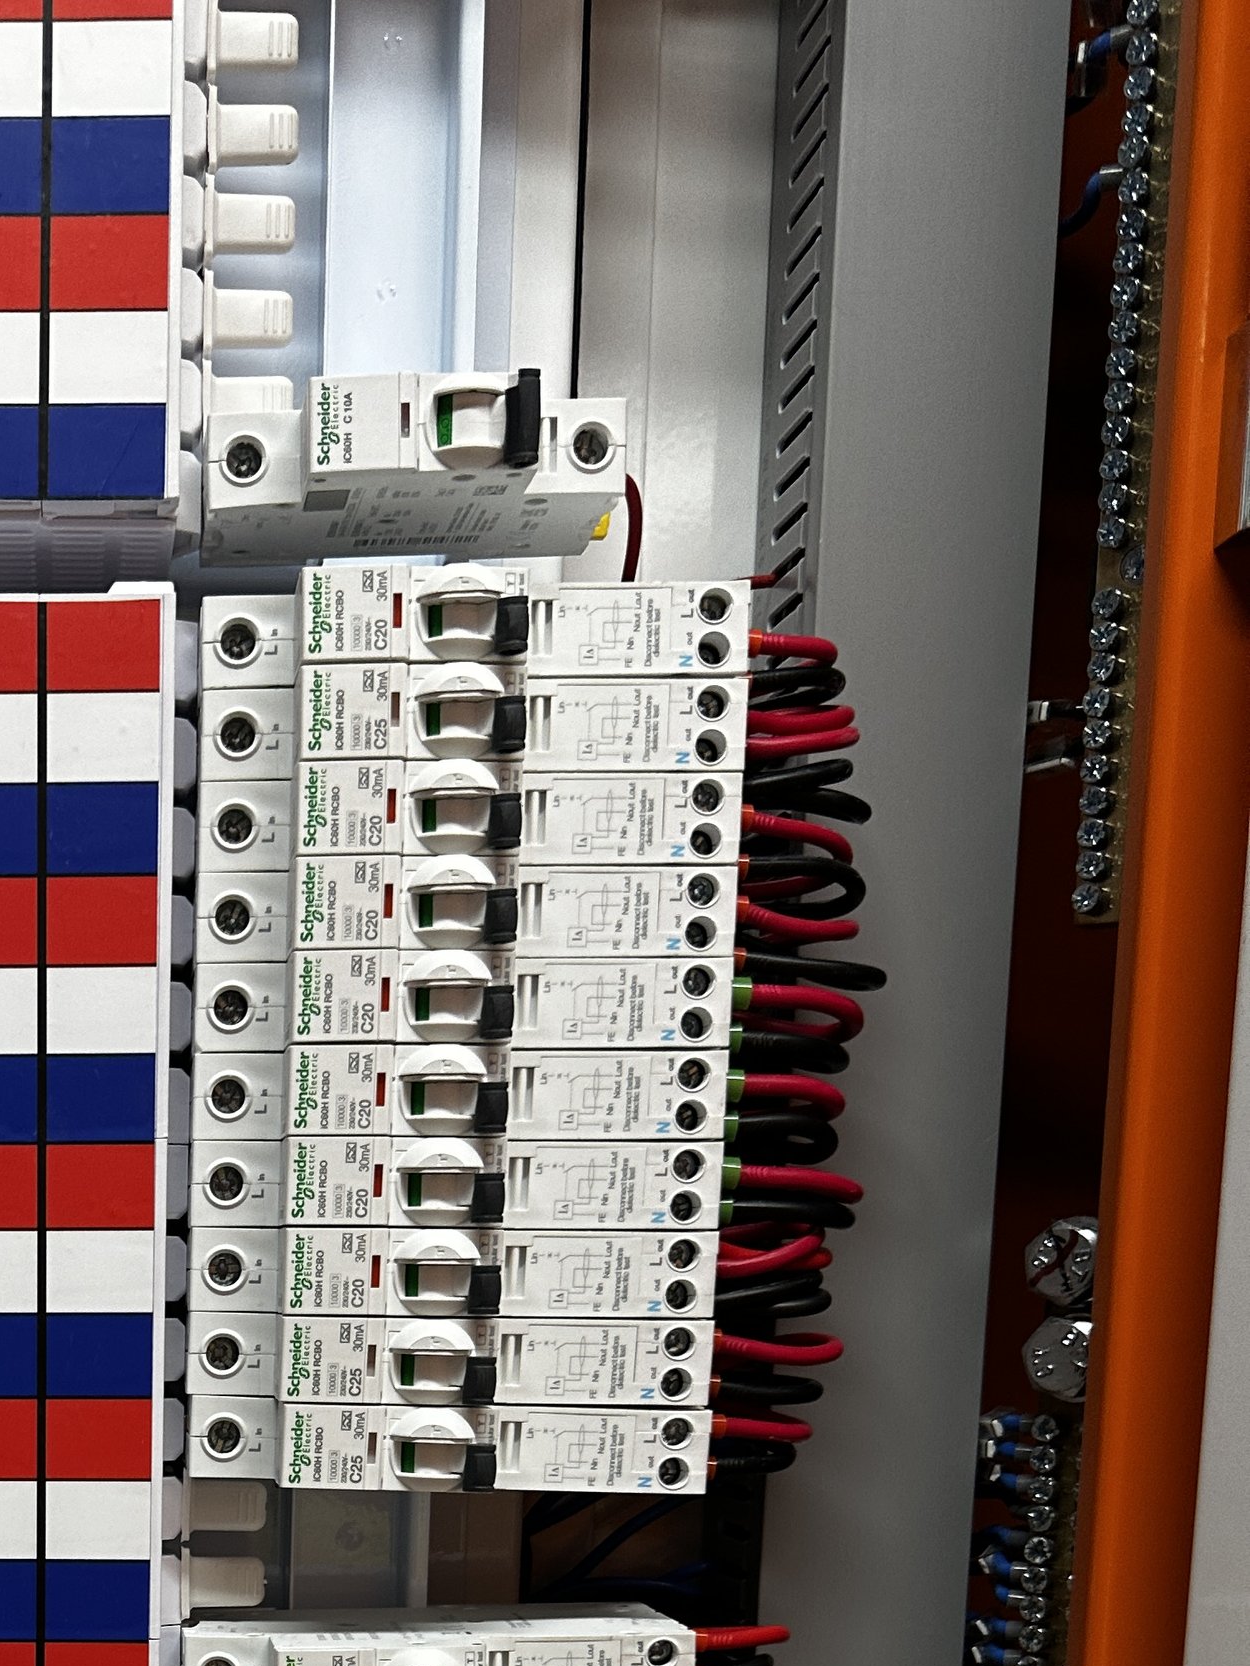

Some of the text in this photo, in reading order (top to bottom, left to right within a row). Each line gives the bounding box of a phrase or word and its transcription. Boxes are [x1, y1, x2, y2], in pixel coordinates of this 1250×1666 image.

[317, 383, 330, 465] Schneider
[331, 384, 339, 429] Electric
[344, 392, 352, 412] 10A
[308, 573, 322, 653] Schneider
[374, 570, 387, 650] C20 30mA
[681, 608, 694, 618] L
[679, 655, 693, 667] N
[308, 671, 322, 751] Schneider
[374, 719, 387, 749] C25
[303, 767, 317, 846] Schneider
[369, 816, 382, 846] C20
[300, 863, 314, 942] Schneider
[365, 910, 378, 941] C20
[297, 957, 311, 1035] Schneider
[361, 1003, 374, 1034] C20
[294, 1052, 308, 1128] Schneider
[358, 1100, 371, 1129] C20
[292, 1143, 305, 1218] Schneider
[355, 1143, 370, 1218] C20 30mA
[290, 1234, 303, 1308] Schneider
[351, 1279, 364, 1308] C20
[287, 1324, 300, 1396] Schneider
[349, 1368, 362, 1396] C25
[289, 1412, 301, 1483] Schneider
[350, 1456, 363, 1483] C25
